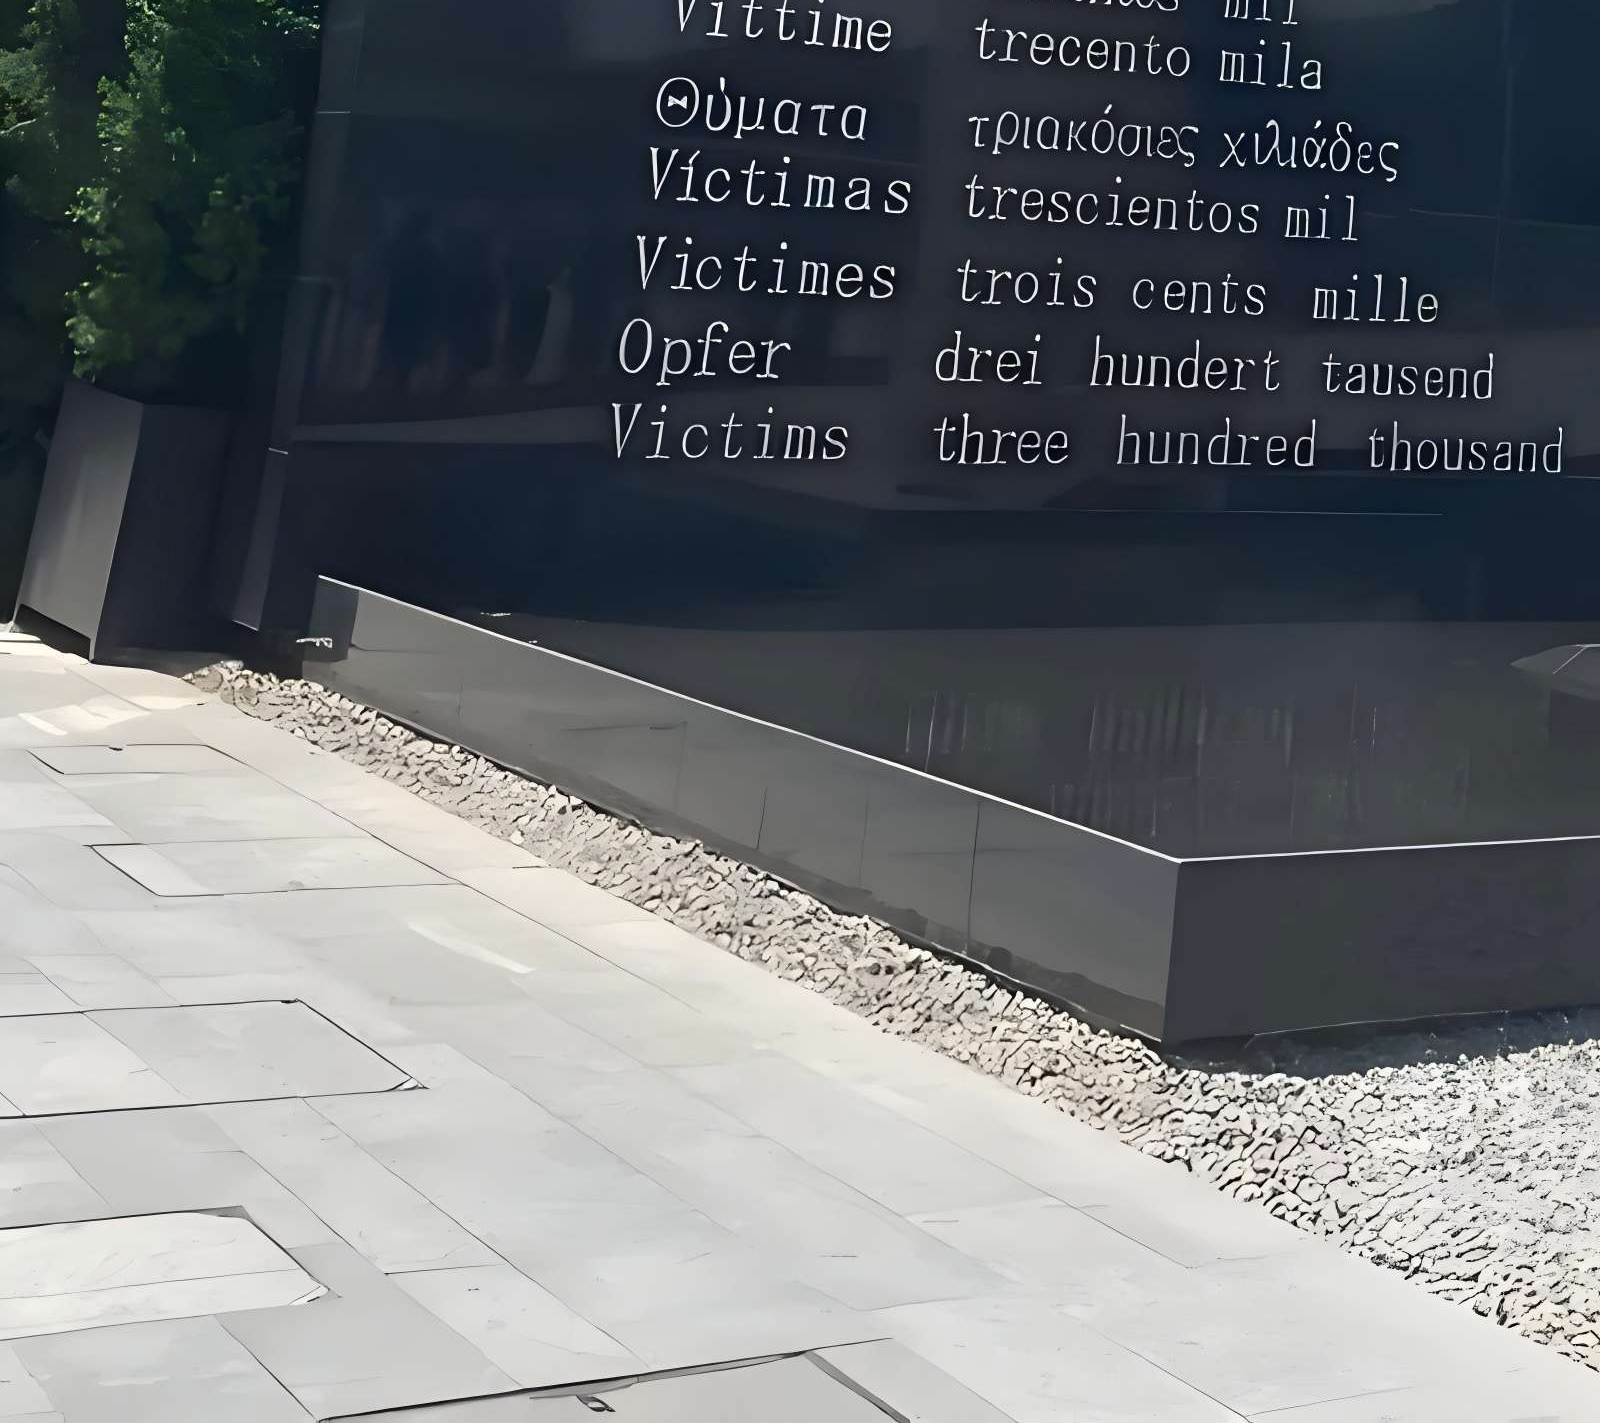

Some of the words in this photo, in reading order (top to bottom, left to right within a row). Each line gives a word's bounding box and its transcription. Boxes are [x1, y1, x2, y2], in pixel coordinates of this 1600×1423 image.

[974, 18, 1191, 77] trecento
[1219, 40, 1322, 90] mila
[655, 76, 867, 141] Θύματα
[649, 146, 911, 214] Víctimas
[964, 173, 1260, 235] trescientos
[1283, 194, 1359, 242] mil
[636, 234, 896, 299] Victimes
[956, 256, 1097, 308] trois
[1132, 271, 1266, 316] cents
[1312, 273, 1439, 323] mille
[618, 317, 792, 387] Opfer
[935, 330, 1042, 385] drei
[1089, 334, 1280, 393] hundert
[1322, 350, 1494, 400] tausend
[611, 402, 849, 460] Victims
[933, 412, 1069, 465] three
[1116, 413, 1317, 467] hundred
[1368, 420, 1563, 474] thousand
